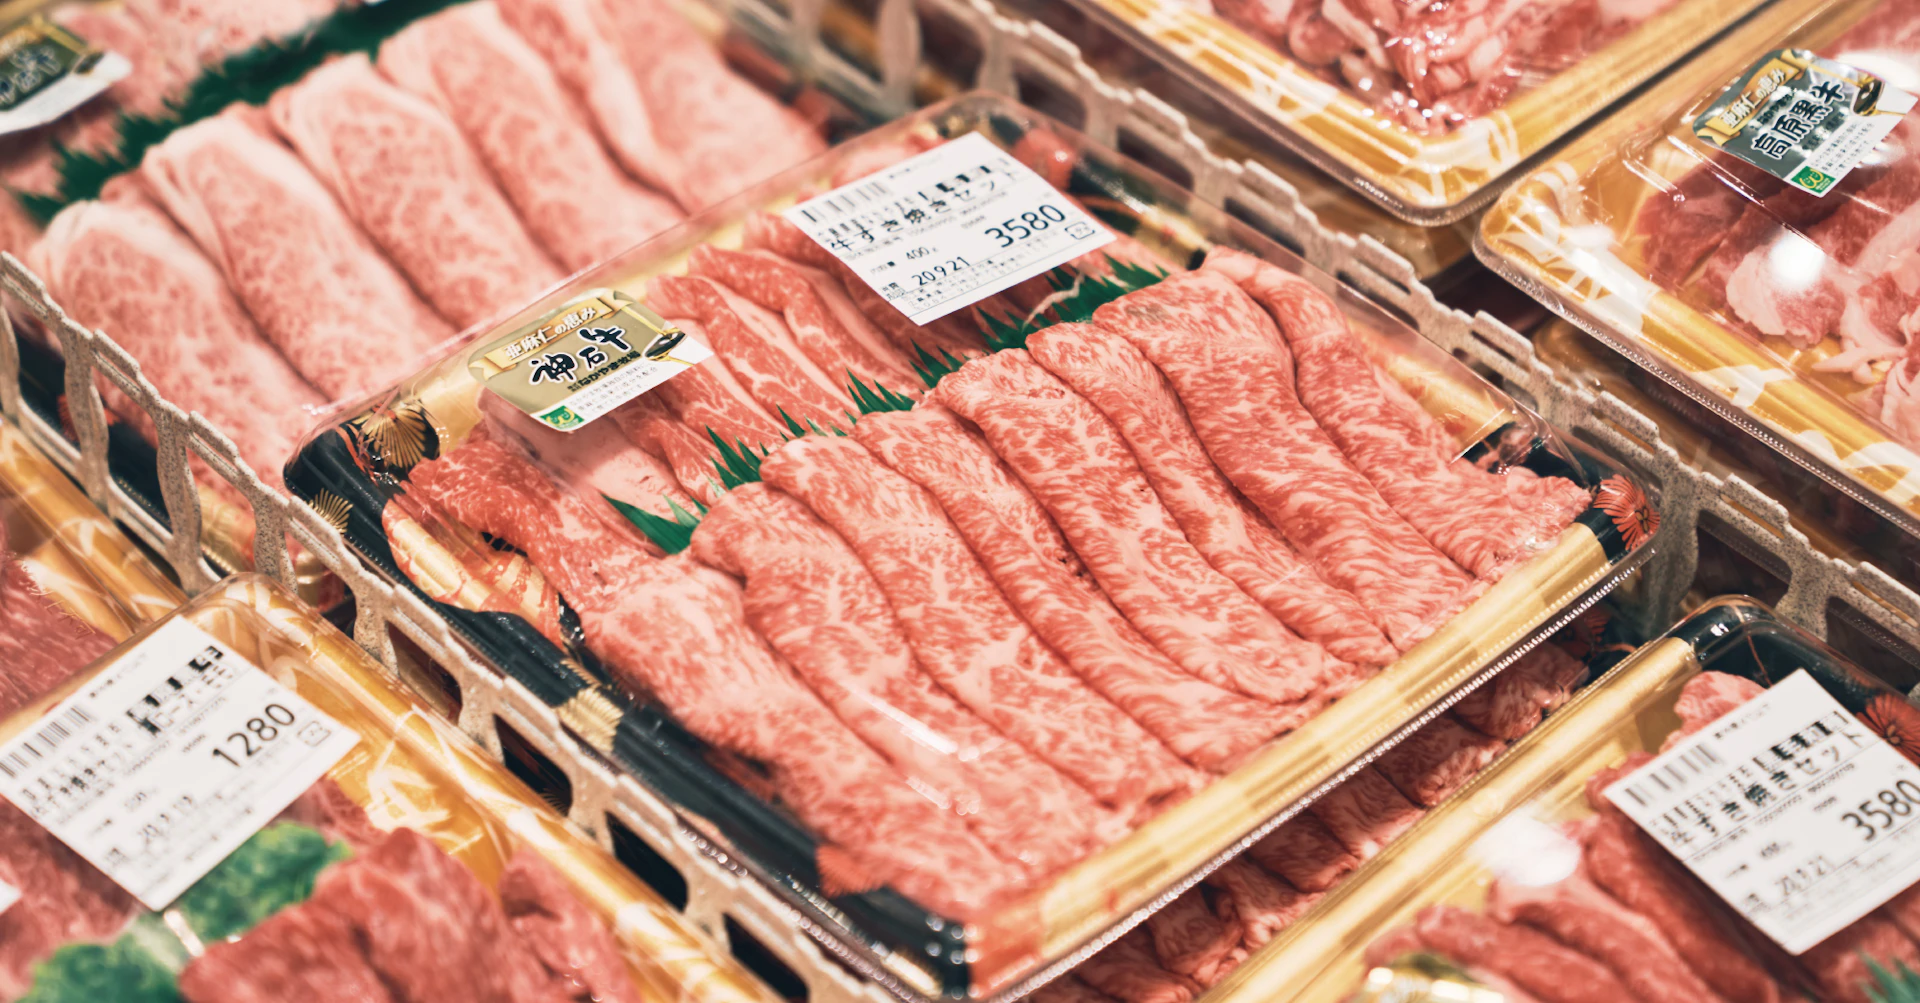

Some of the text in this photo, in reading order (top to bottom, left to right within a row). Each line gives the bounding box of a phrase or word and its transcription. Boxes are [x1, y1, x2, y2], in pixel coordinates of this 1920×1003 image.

[1751, 80, 1845, 160] 高原黒牛
[984, 204, 1066, 248] 3580
[504, 306, 597, 360] 亜麻仁の恵み
[530, 327, 632, 384] 神石牛
[212, 702, 296, 768] 1280
[1841, 779, 1920, 842] 3580
